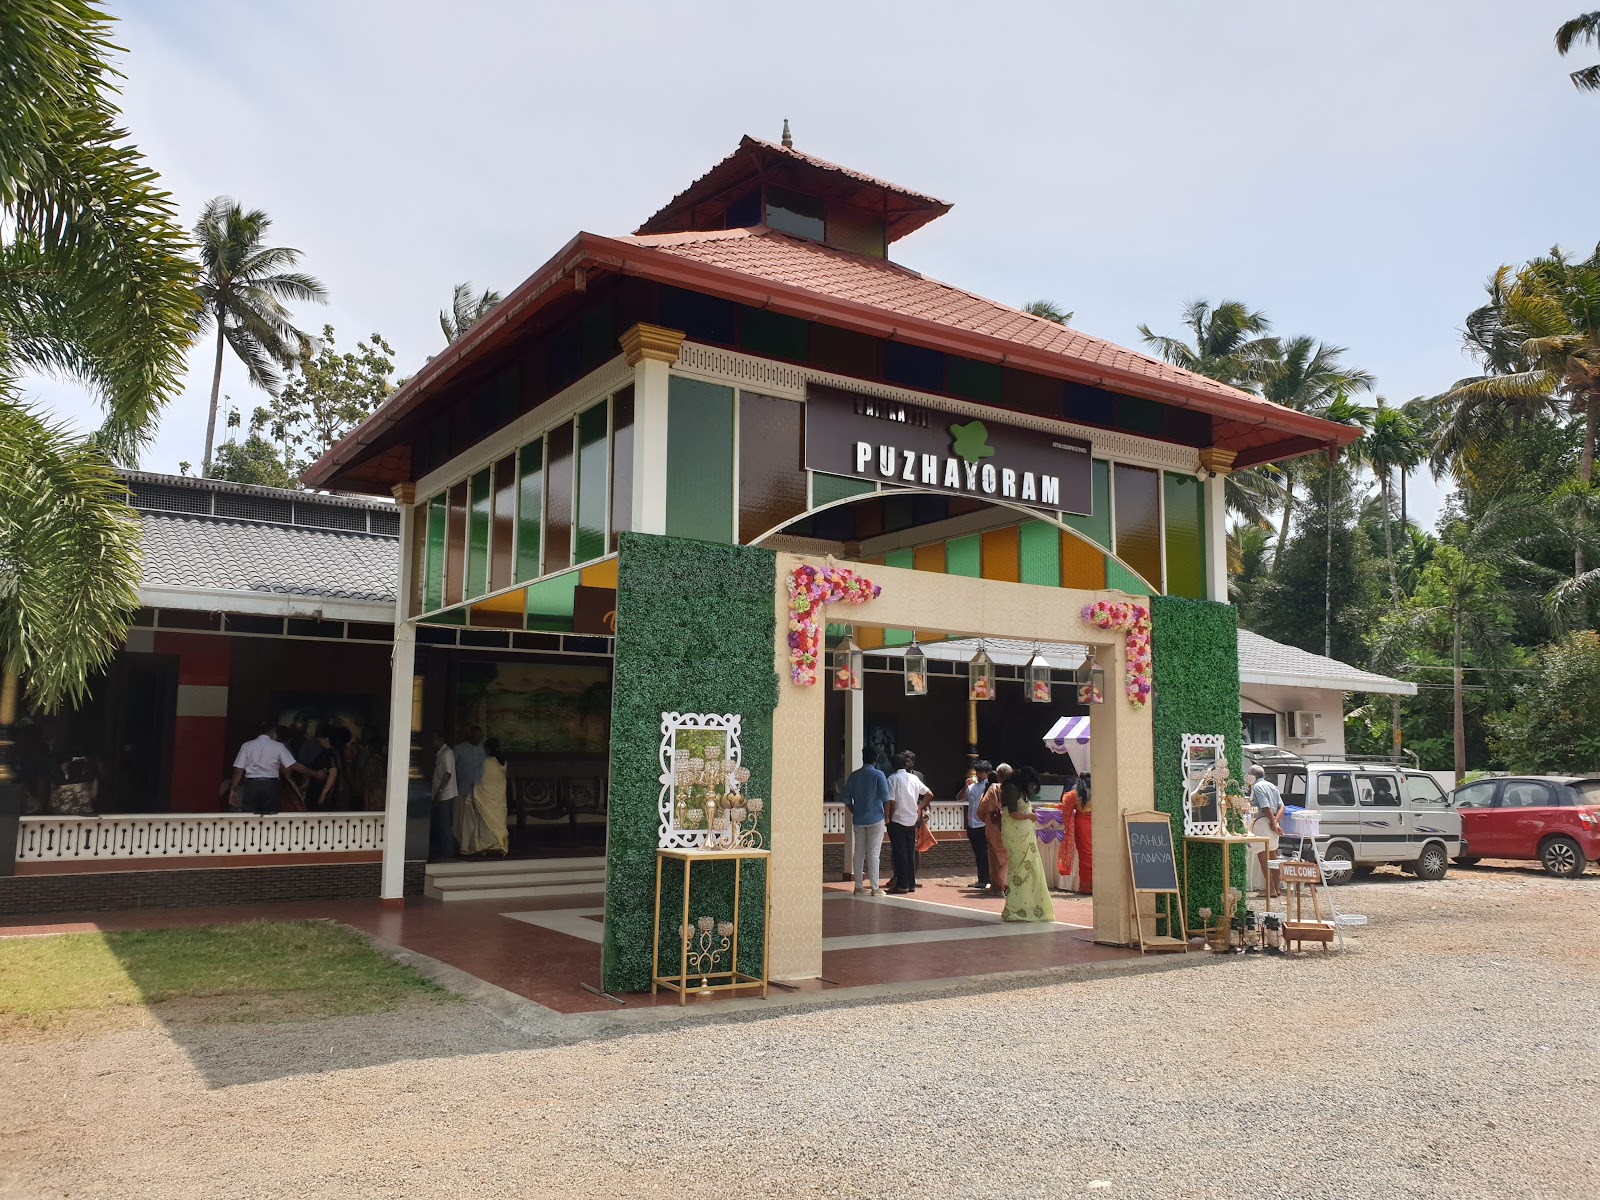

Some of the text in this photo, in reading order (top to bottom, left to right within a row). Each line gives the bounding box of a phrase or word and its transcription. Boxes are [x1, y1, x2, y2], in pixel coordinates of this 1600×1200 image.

[856, 441, 1060, 505] PUZHAYORAM
[1131, 833, 1168, 847] RAHUL
[1283, 865, 1318, 878] WELCOME
